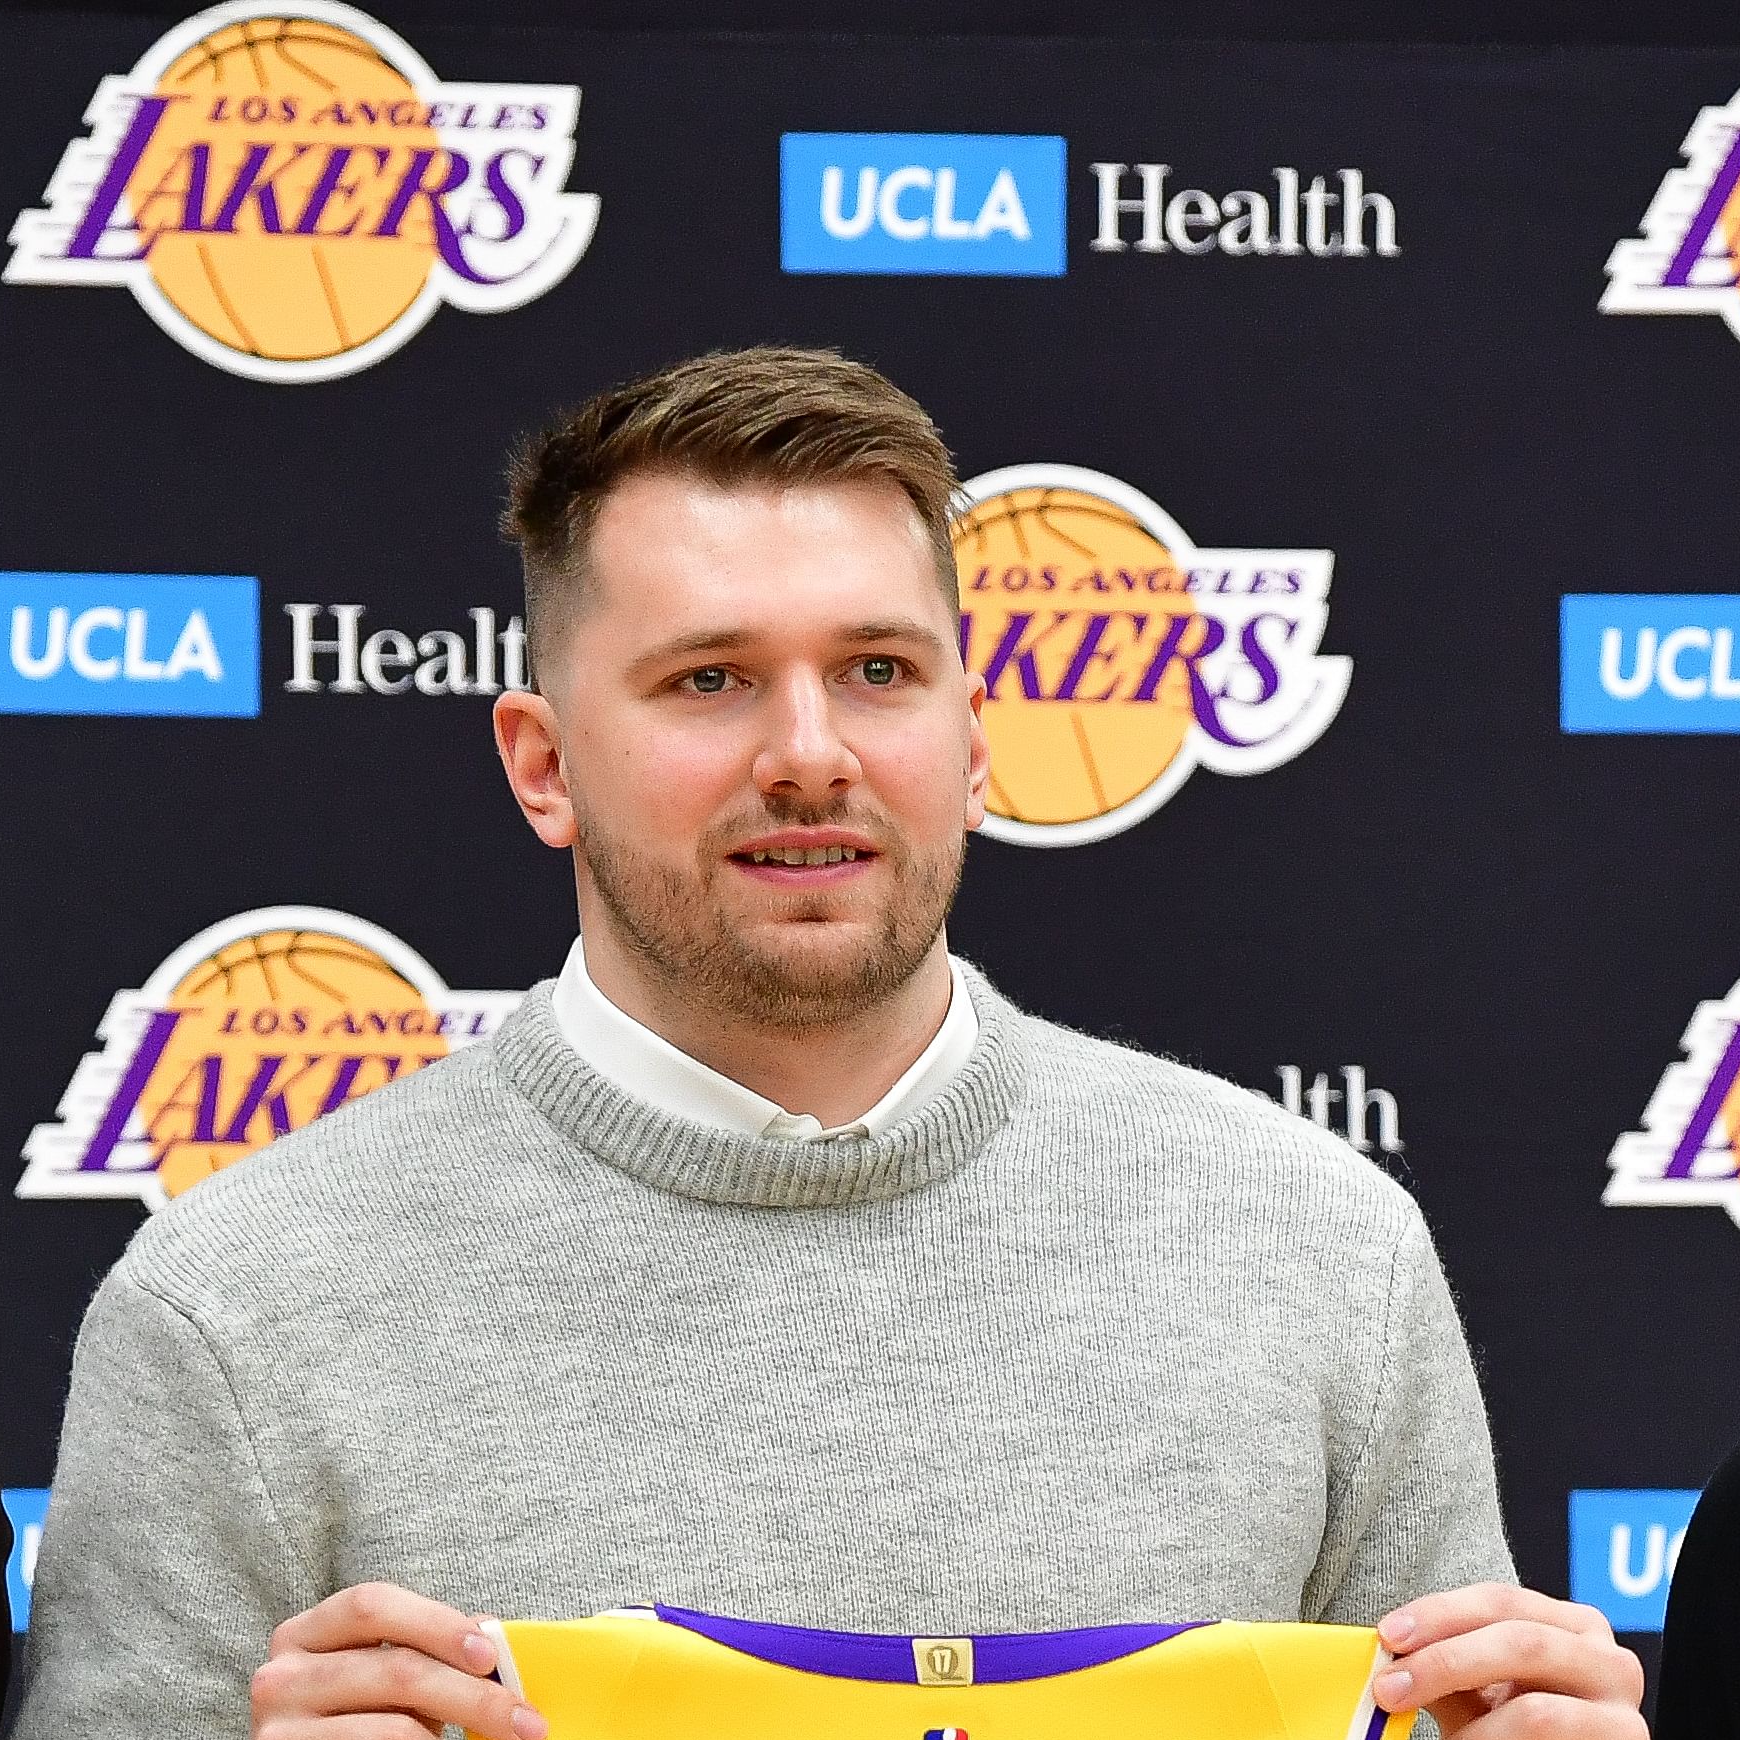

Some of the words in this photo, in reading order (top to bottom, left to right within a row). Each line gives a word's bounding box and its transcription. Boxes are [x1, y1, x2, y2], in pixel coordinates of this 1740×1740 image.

[209, 96, 296, 124] LOS
[310, 97, 550, 130] ANGELES
[35, 93, 568, 285] LAKERS
[820, 165, 1031, 240] UCLA
[1090, 162, 1402, 257] Health
[969, 566, 1061, 593] LOS
[1071, 567, 1303, 595] ANGELES
[10, 605, 223, 683] UCLA
[283, 603, 536, 697] Healt
[960, 611, 1324, 748] KERS
[216, 1008, 307, 1036] LOS
[322, 1008, 493, 1036] ANGEL
[1245, 1064, 1407, 1151] lth
